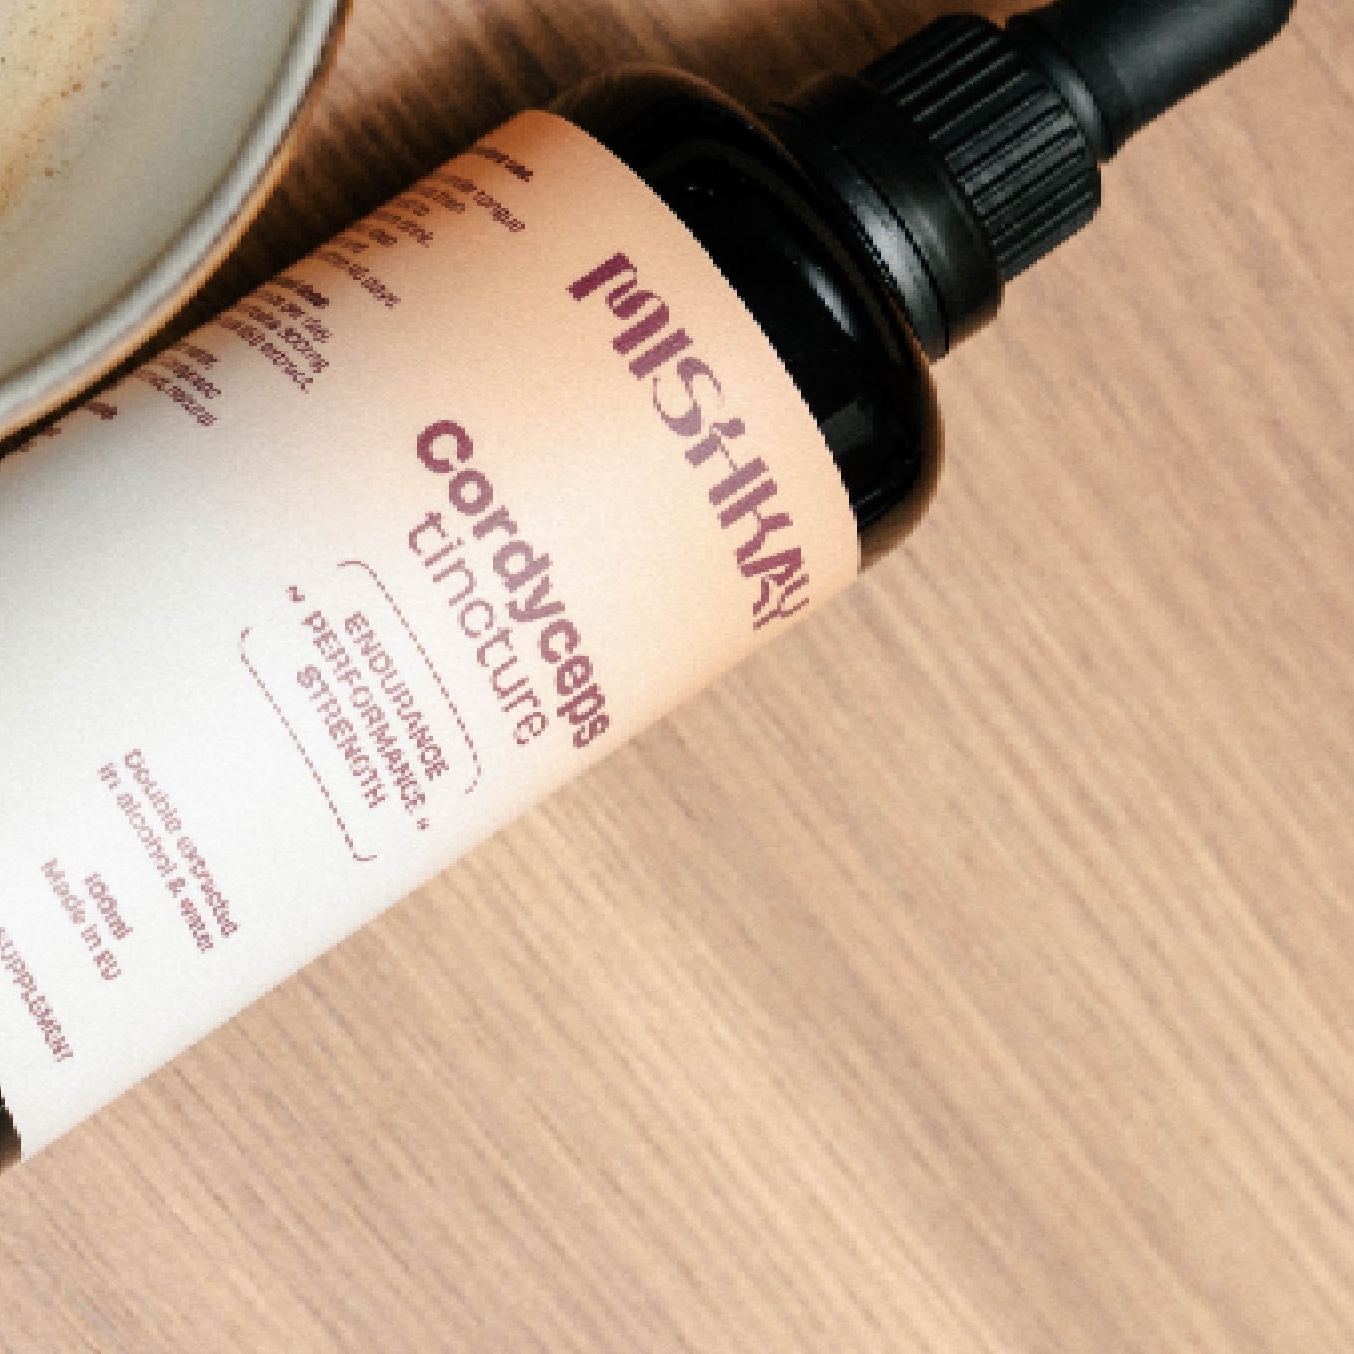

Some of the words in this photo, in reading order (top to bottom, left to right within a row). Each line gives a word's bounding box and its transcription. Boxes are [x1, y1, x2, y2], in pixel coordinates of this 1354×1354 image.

[407, 510, 550, 745] tincture
[416, 419, 610, 748] Cordyceps
[296, 663, 386, 808] STRENGTH
[301, 609, 425, 815] PERFORMANCE
[346, 610, 449, 781] ENDURANCE
[83, 871, 134, 940] 100ml
[97, 762, 122, 790] in
[116, 793, 178, 878] alcohol
[124, 747, 183, 834] Double
[176, 836, 241, 939] extracted
[40, 856, 86, 926] Made
[80, 923, 103, 952] in
[93, 948, 122, 982] EU
